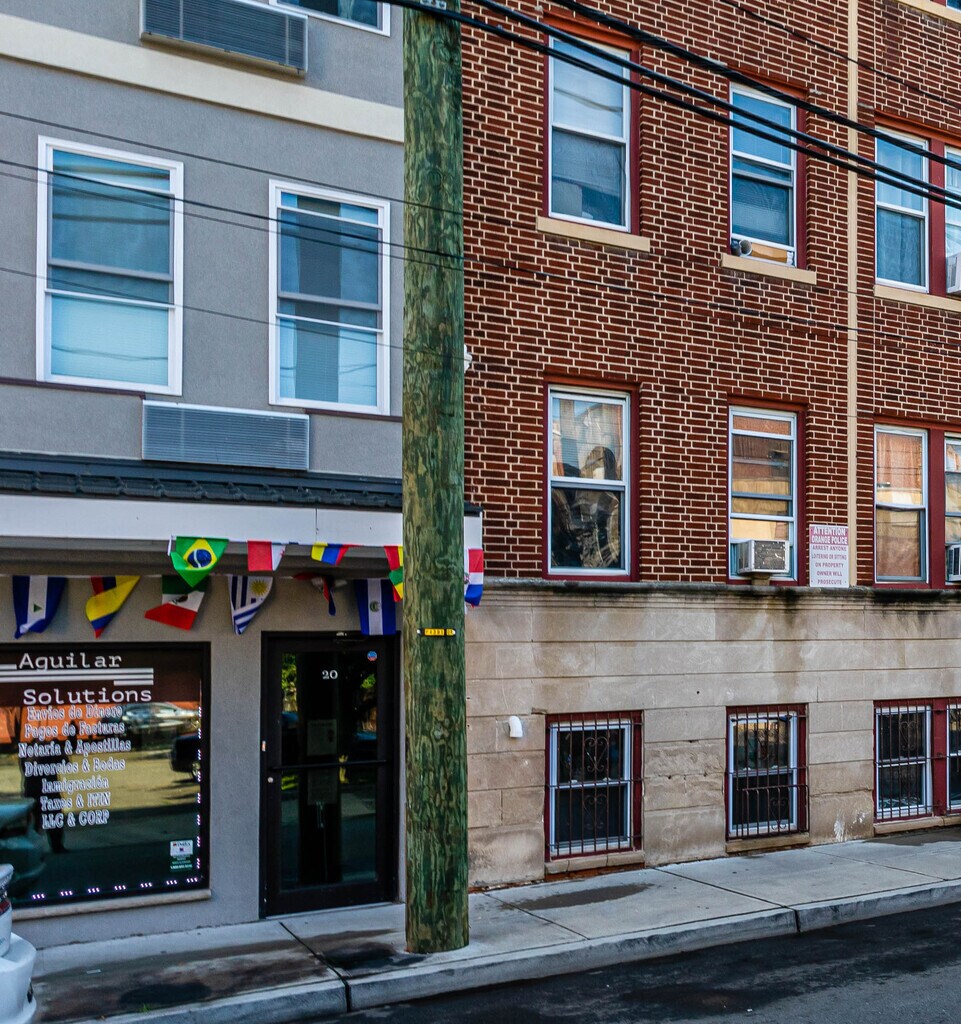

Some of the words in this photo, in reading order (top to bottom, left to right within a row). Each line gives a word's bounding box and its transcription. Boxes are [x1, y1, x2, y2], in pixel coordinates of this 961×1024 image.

[811, 536, 831, 544] ORANGE
[831, 536, 848, 545] POLICE
[813, 526, 846, 536] ATTENTION
[19, 652, 122, 671] Aguilar
[322, 669, 338, 680] 20
[23, 687, 152, 705] Solutions
[68, 704, 82, 719] de
[85, 704, 123, 718] Dinero
[24, 723, 59, 741] Pagos
[62, 721, 76, 736] de
[79, 720, 125, 735] Facturas
[64, 739, 73, 755] &
[75, 737, 132, 757] Apostillas
[24, 759, 79, 777] Divorcios
[82, 757, 90, 773] &
[93, 756, 126, 772] Bodas
[40, 796, 73, 811] Taxes
[75, 794, 84, 808] &
[87, 791, 111, 807] ITIN
[41, 813, 64, 829] LLC
[67, 812, 76, 827] &
[79, 809, 110, 826] CORP
